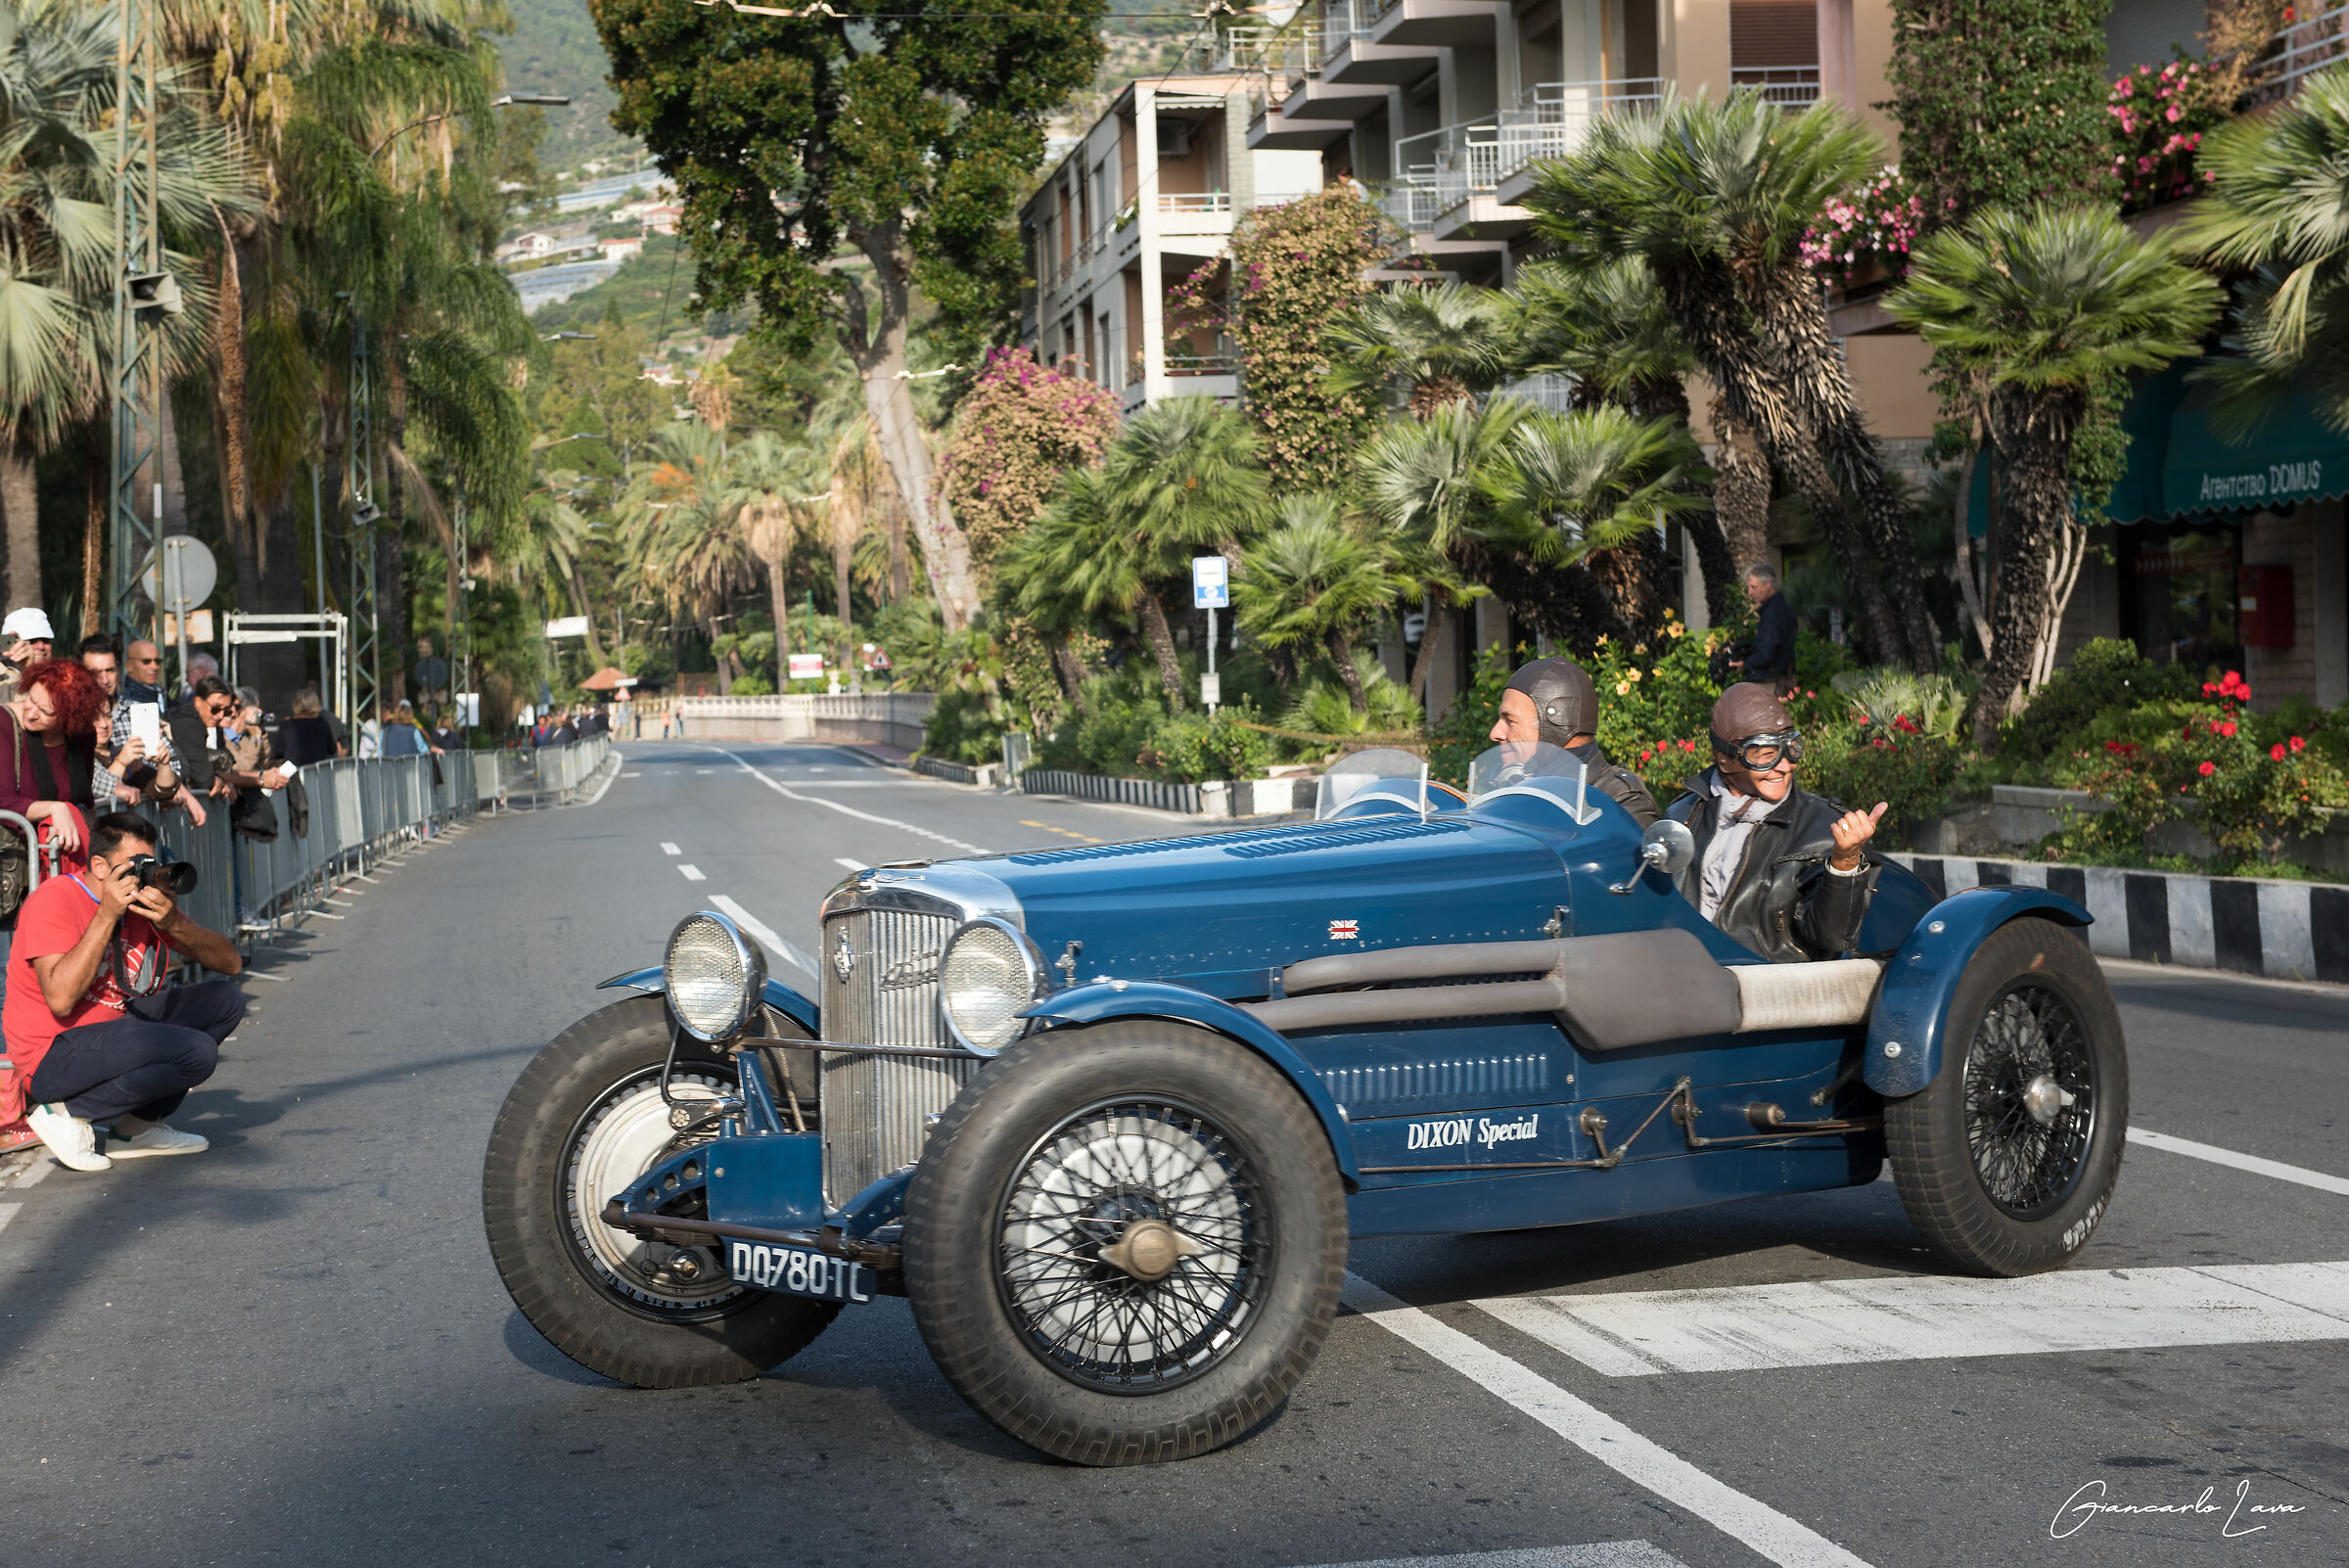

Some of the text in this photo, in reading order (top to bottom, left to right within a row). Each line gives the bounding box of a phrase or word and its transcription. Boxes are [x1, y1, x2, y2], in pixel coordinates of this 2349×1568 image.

[2200, 459, 2322, 500] Агентство DOMUS
[1407, 1113, 1539, 1150] DIXON Special
